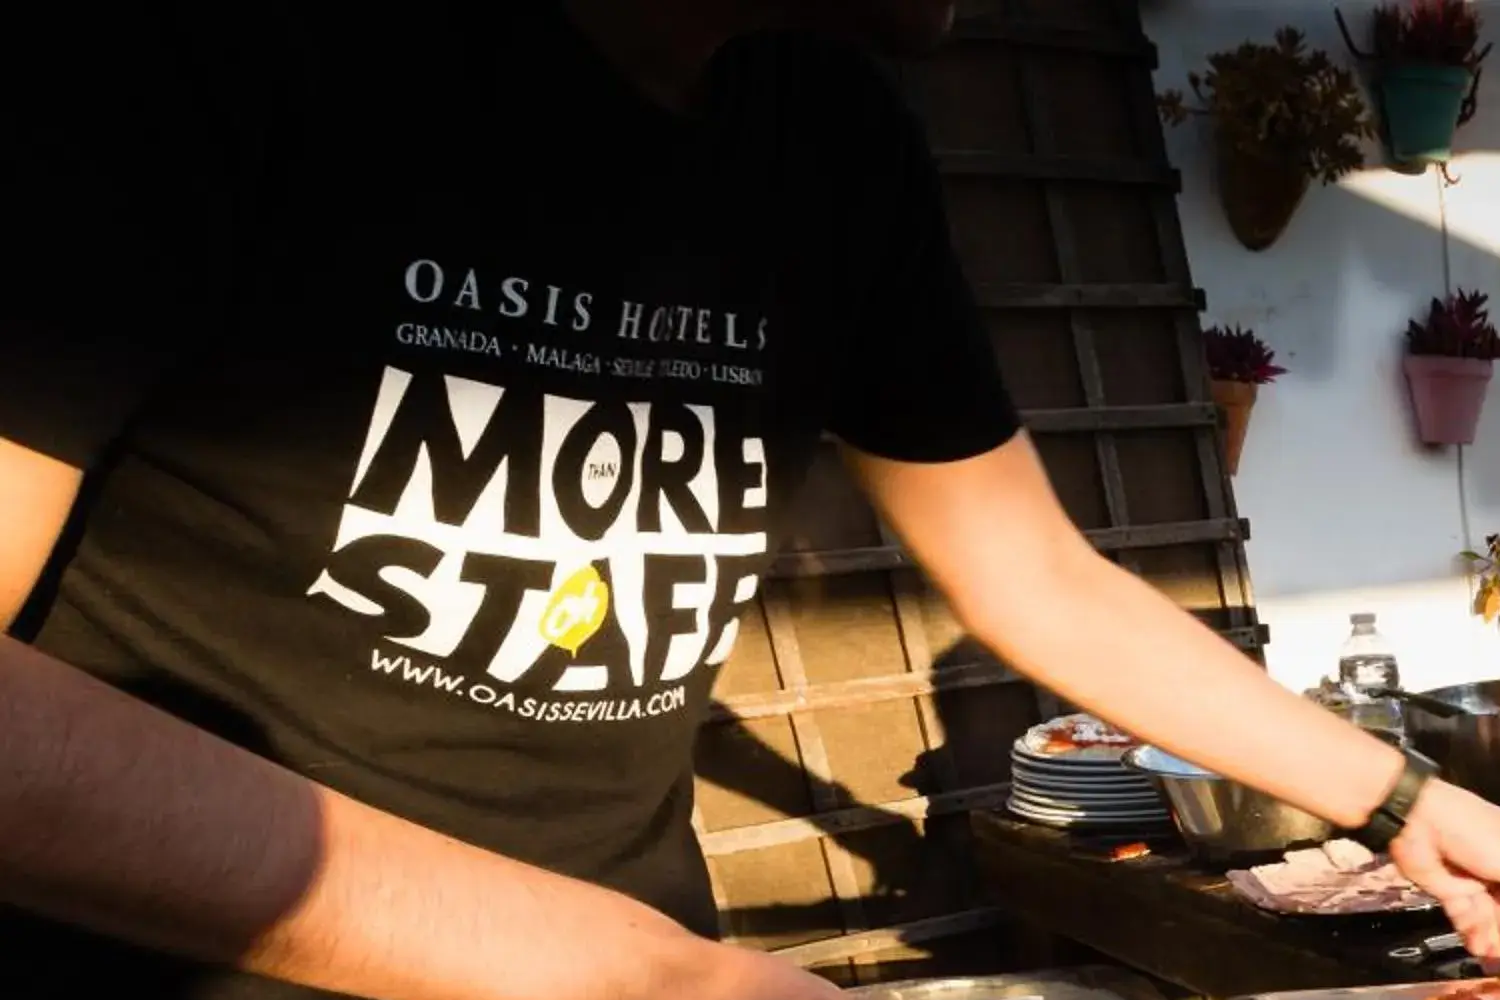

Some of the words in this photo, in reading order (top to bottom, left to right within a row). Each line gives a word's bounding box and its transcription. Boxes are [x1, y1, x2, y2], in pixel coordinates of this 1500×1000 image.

[404, 258, 593, 332] OASIS
[396, 322, 502, 357] GRANADA
[345, 367, 768, 541] MORE
[587, 462, 618, 481] THAN
[320, 534, 756, 692] STAFF
[371, 648, 686, 722] WWW.OASISSEVILLA.COM
